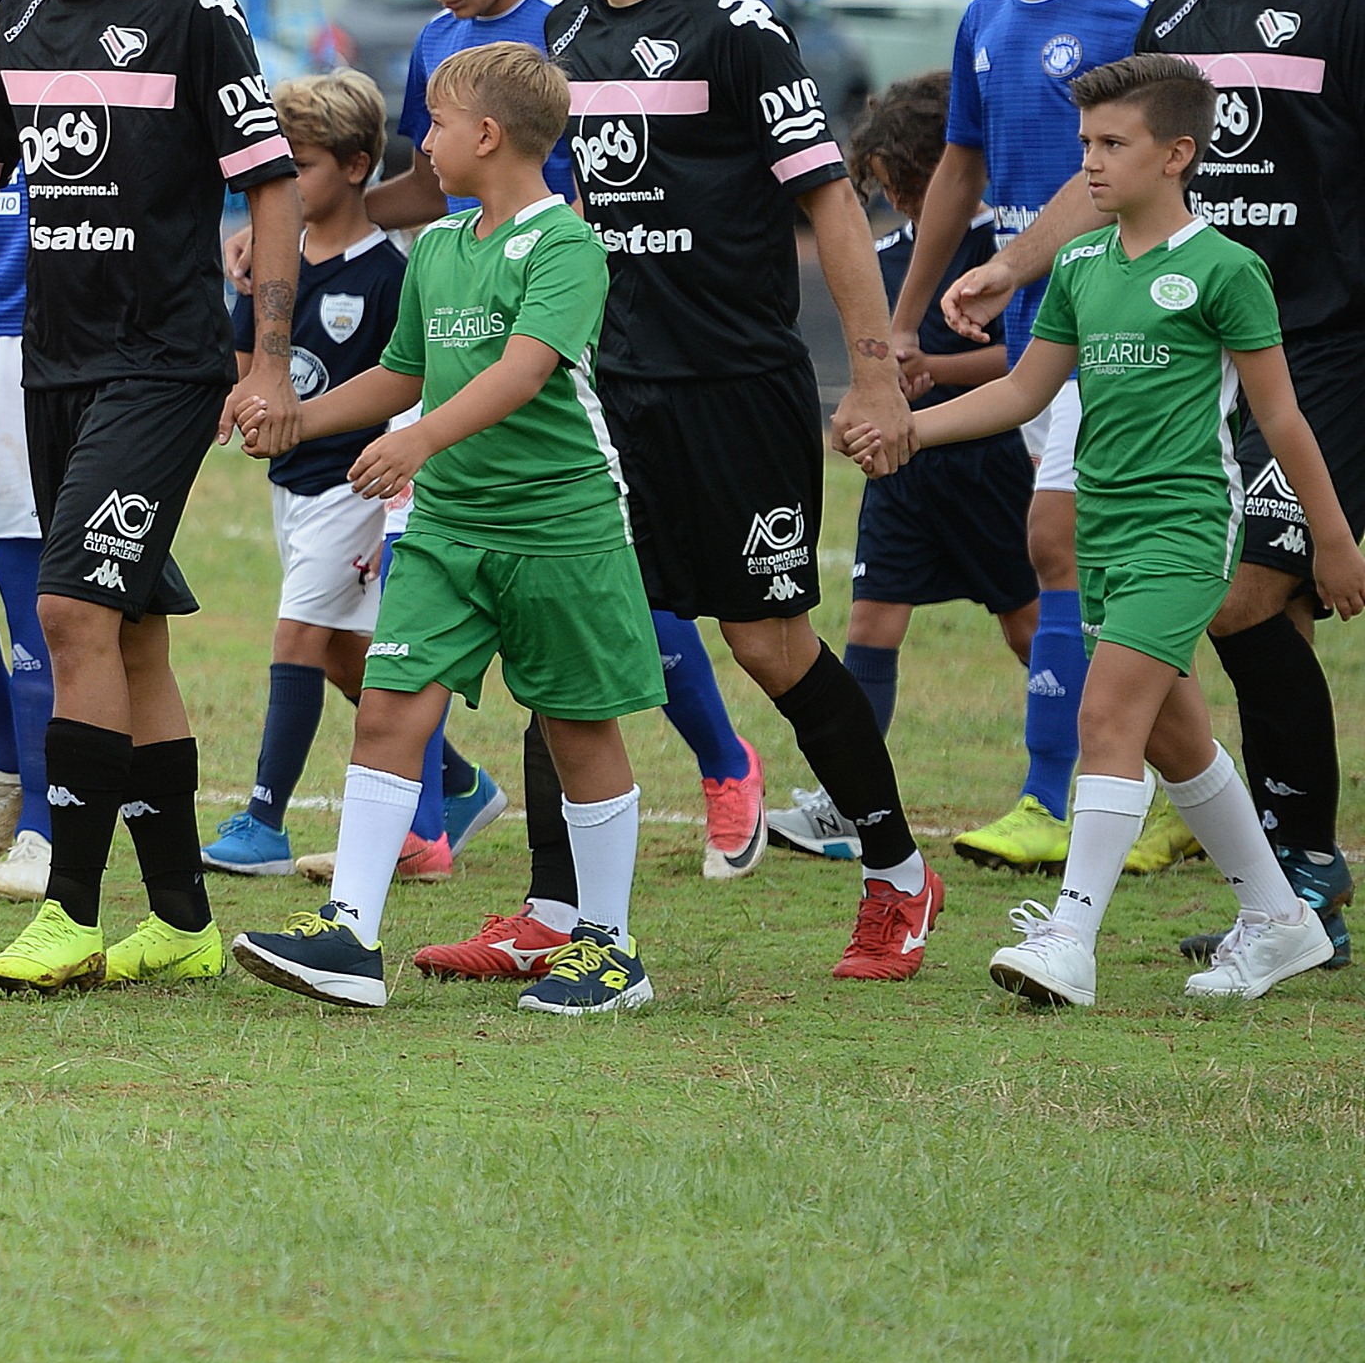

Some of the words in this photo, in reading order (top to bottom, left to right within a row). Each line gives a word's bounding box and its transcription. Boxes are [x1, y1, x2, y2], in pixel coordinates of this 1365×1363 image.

[28, 181, 119, 199] gruppoarena.it
[29, 217, 136, 252] isaten
[1062, 243, 1107, 266] LEGE
[426, 312, 506, 337] ELLARIUS
[1244, 505, 1270, 517] CLUB
[83, 540, 108, 554] CLUB
[747, 545, 809, 566] AUTOMOBILE
[748, 565, 772, 576] CLUB
[773, 555, 810, 575] PALERMO
